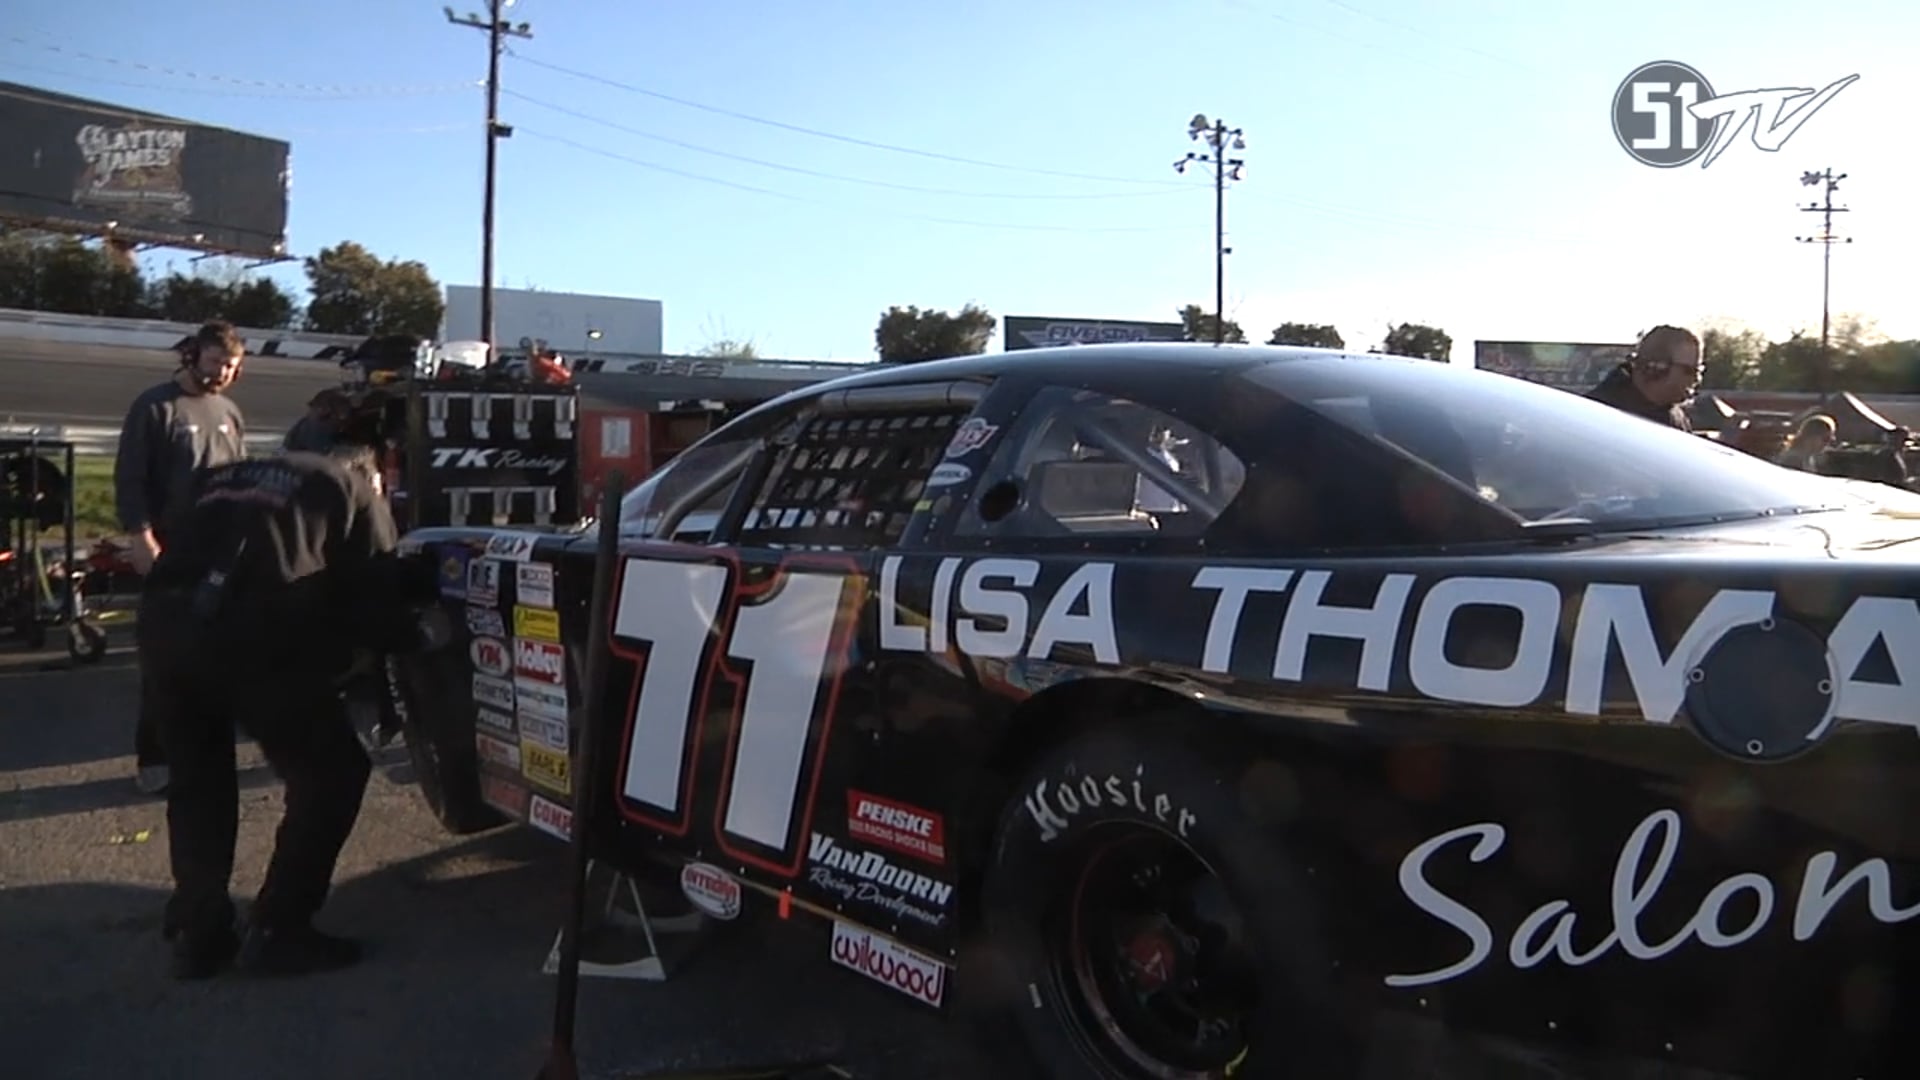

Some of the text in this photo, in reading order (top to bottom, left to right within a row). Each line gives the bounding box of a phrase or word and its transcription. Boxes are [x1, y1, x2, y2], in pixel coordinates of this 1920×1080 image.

[76, 124, 187, 161] CLAYTON
[91, 148, 173, 188] JAMES
[431, 448, 567, 476] TK Racing
[879, 555, 1120, 665] LISA
[856, 799, 934, 838] PENSKE
[1025, 762, 1197, 843] Hoosier
[808, 866, 946, 926] Racing Development
[1384, 808, 1920, 986] Salon
